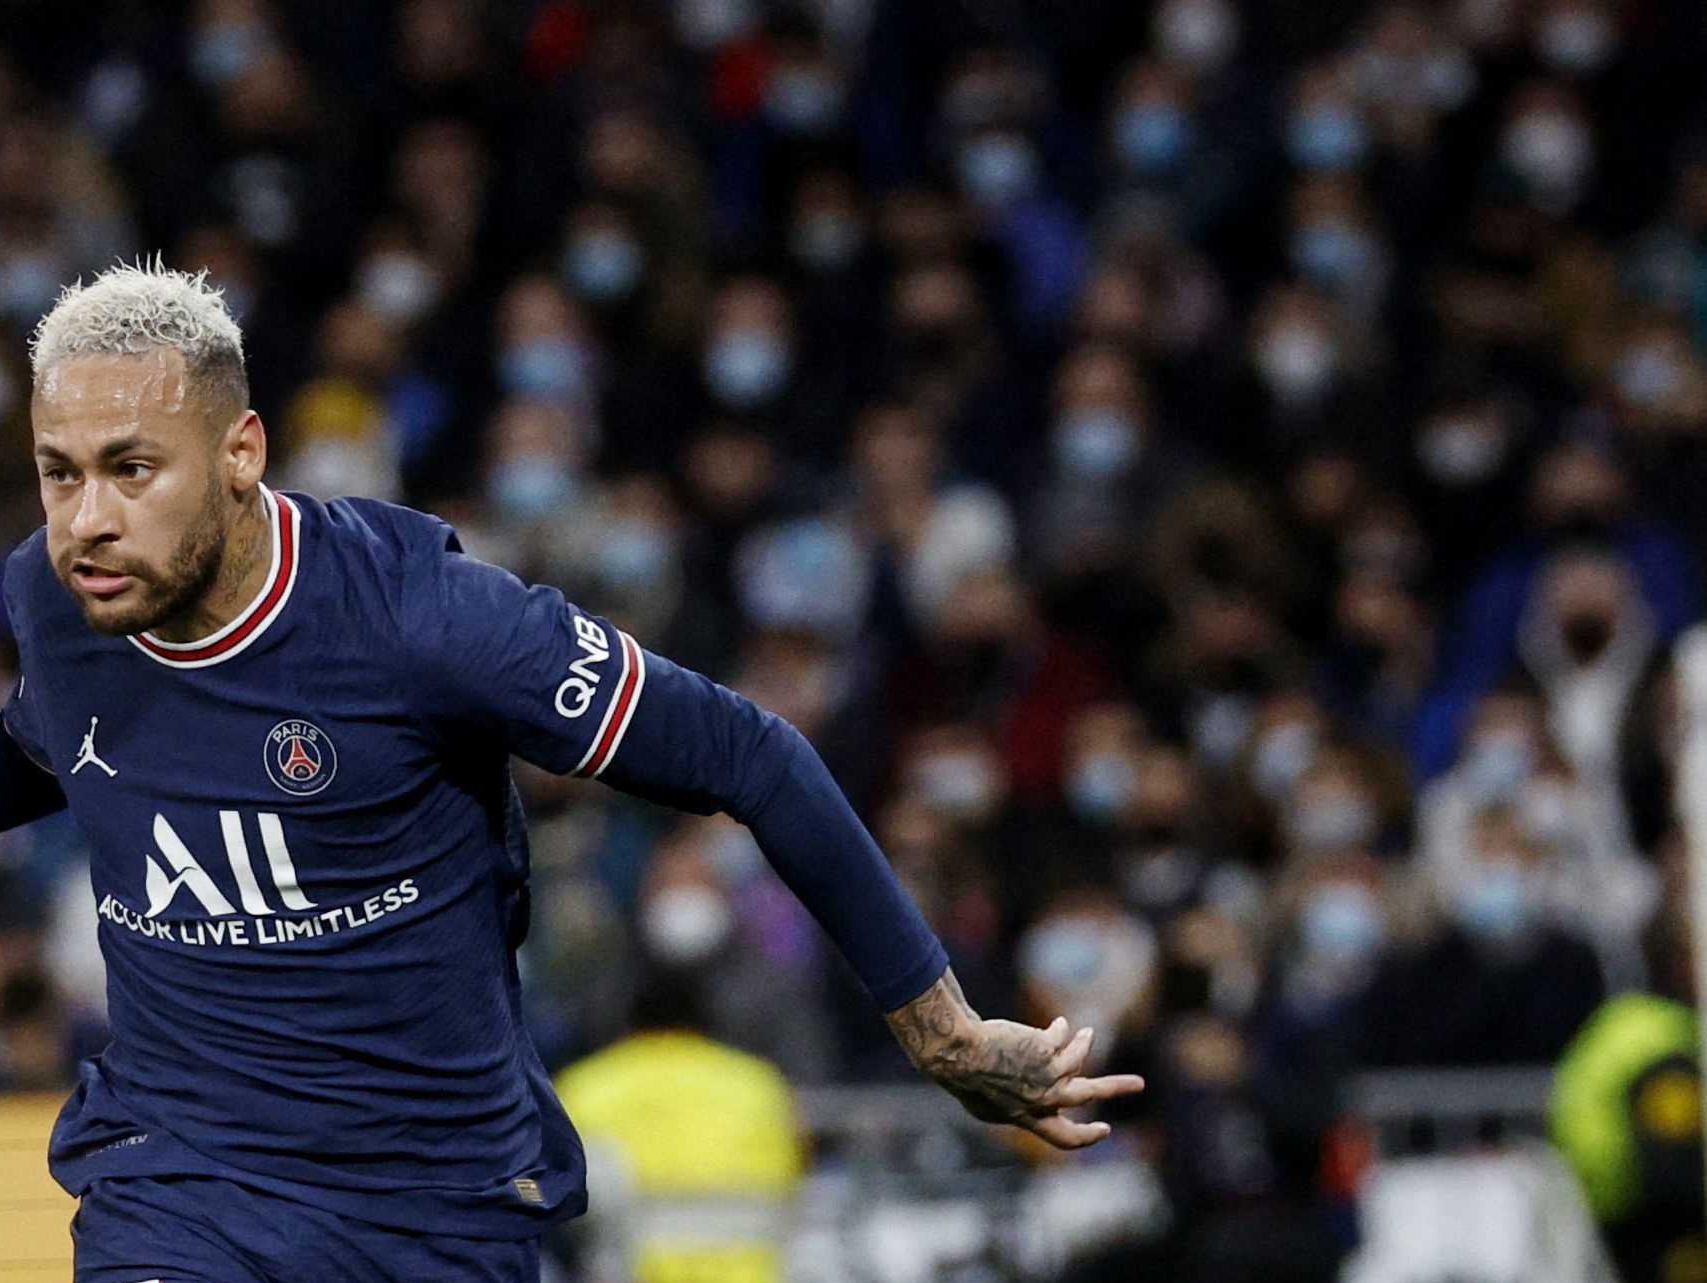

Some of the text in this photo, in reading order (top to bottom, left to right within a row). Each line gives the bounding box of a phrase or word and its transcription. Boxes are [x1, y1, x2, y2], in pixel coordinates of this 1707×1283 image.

[555, 615, 610, 718] QNB
[272, 723, 319, 743] PARIS
[180, 919, 250, 946] LIVE
[255, 879, 420, 945] LIMITLESS
